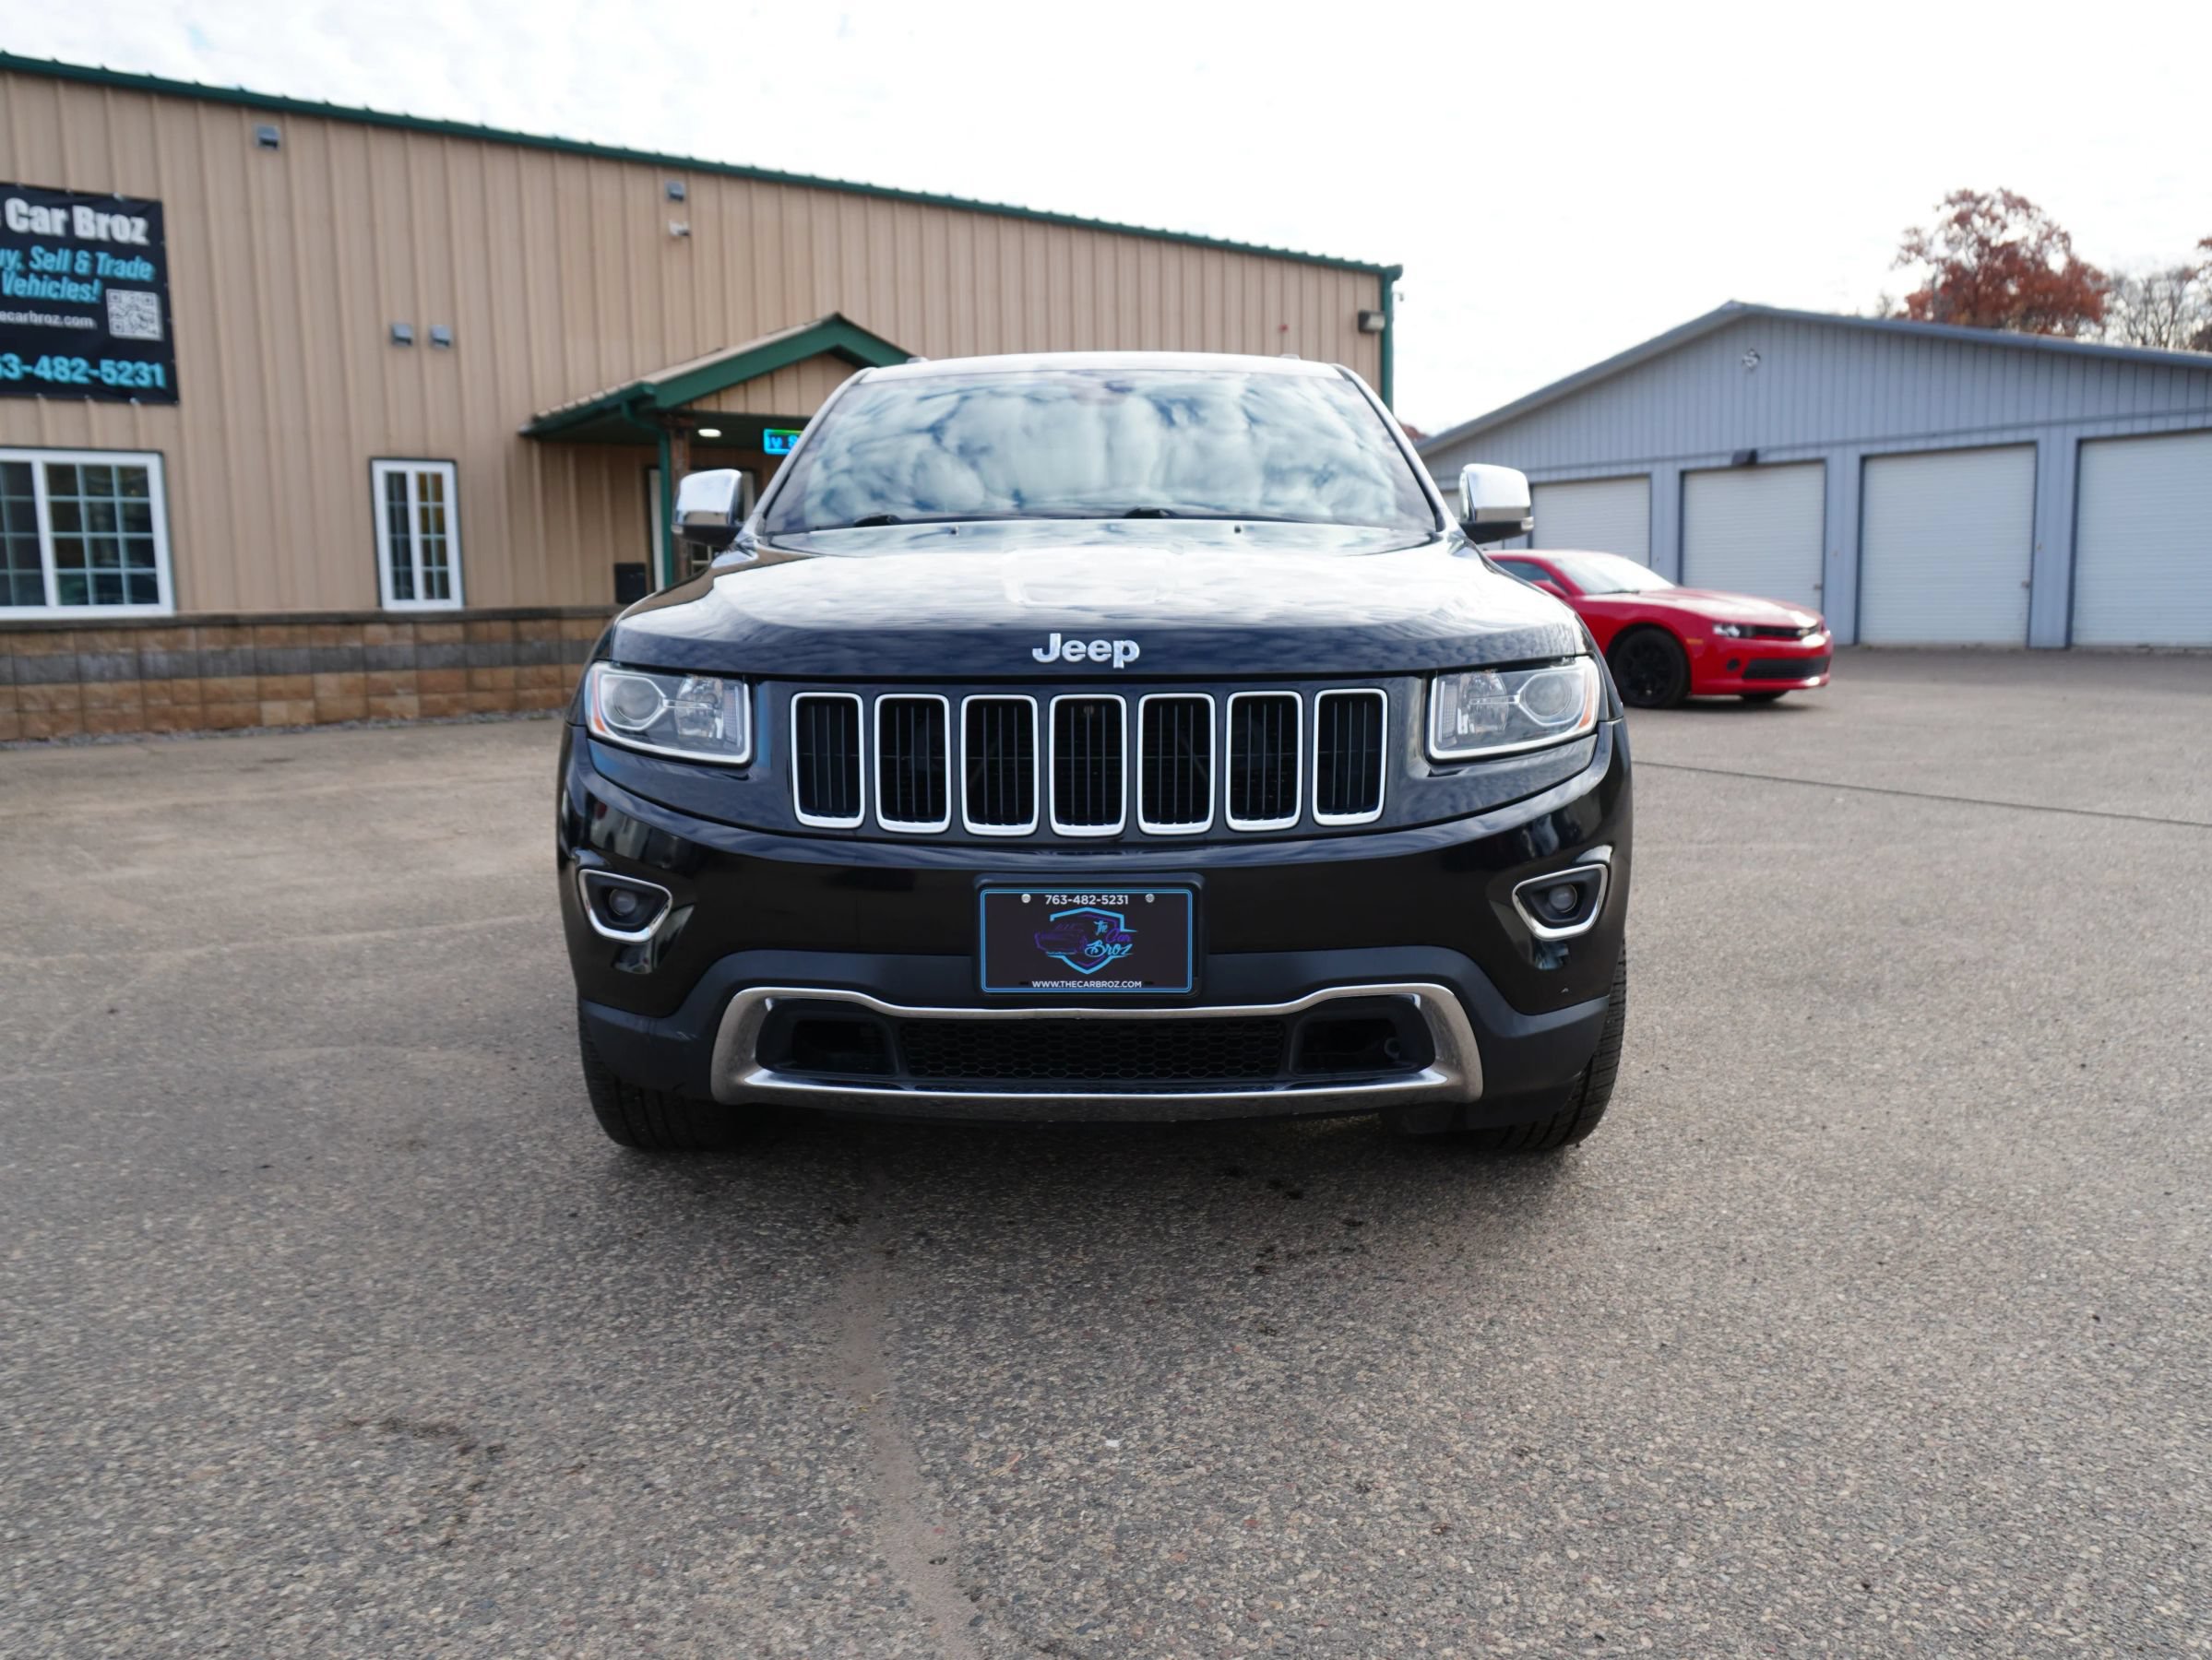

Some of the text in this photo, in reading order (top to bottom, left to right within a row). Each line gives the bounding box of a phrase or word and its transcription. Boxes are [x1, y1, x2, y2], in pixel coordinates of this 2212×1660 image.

[5, 197, 149, 245] Car Broz
[30, 245, 73, 274] Sell
[74, 250, 91, 275] &
[95, 252, 155, 281] Trade
[2, 270, 102, 303] Vehicles!
[0, 353, 167, 388] 3-482-5231
[1032, 633, 1140, 669] Jeep
[1045, 895, 1129, 905] 763-482-5231
[1031, 980, 1142, 989] WWW.THECARBROZ.COM
